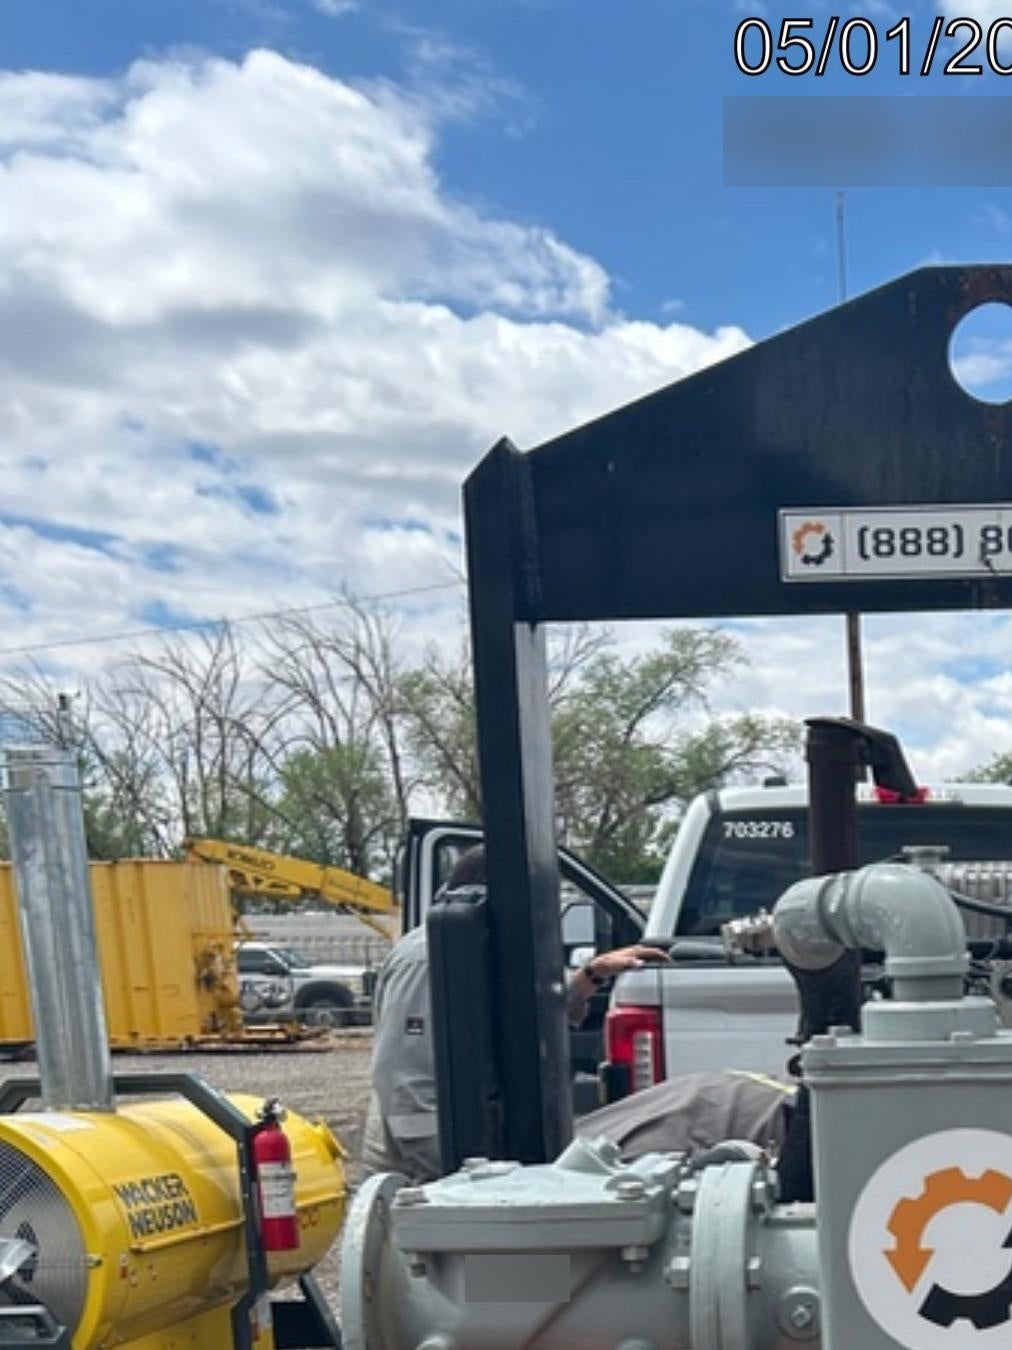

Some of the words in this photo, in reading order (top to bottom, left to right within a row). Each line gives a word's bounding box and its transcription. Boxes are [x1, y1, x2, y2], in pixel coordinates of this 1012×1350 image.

[857, 523, 963, 560] (888)
[722, 820, 795, 838] 703276
[112, 1172, 189, 1208] WACKER
[128, 1198, 198, 1240] NEUSON
